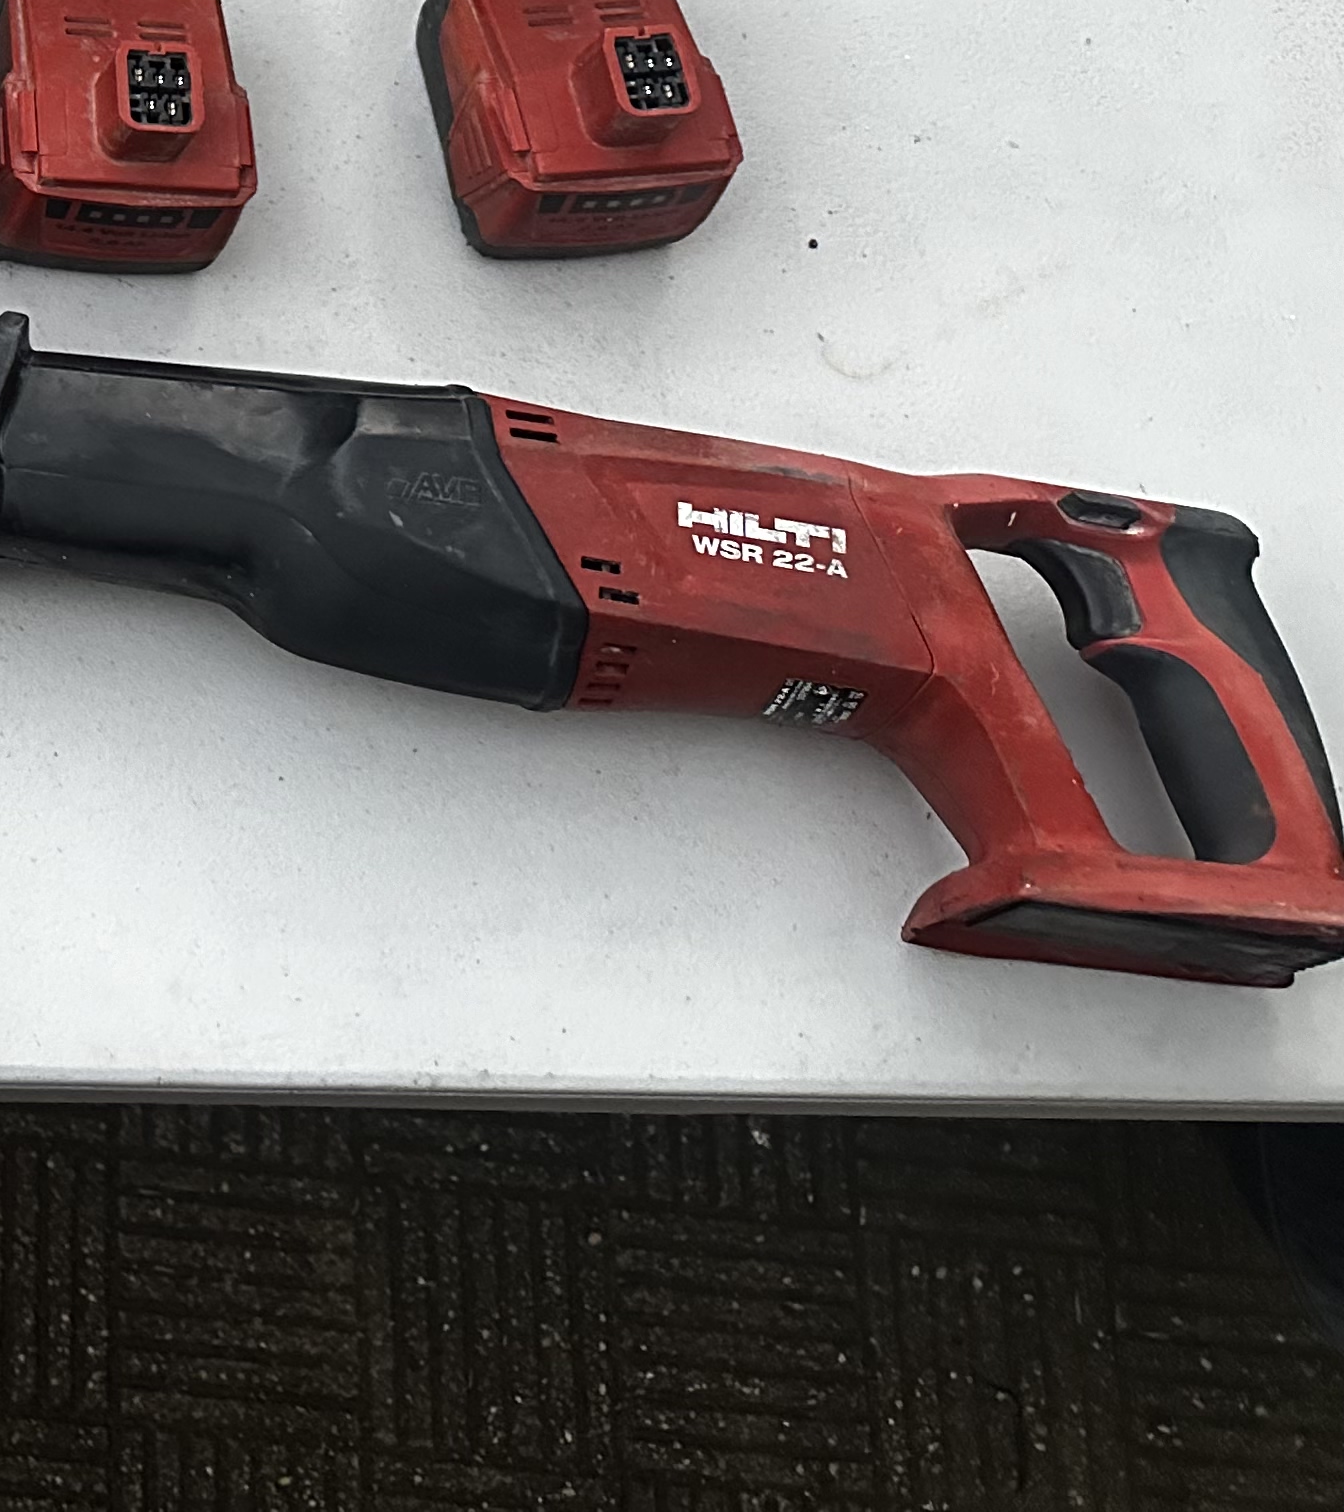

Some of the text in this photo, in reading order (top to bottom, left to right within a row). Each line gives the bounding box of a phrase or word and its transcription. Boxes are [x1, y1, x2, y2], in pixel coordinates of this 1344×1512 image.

[677, 501, 848, 555] HILTI
[692, 534, 849, 580] WSR 22-A
